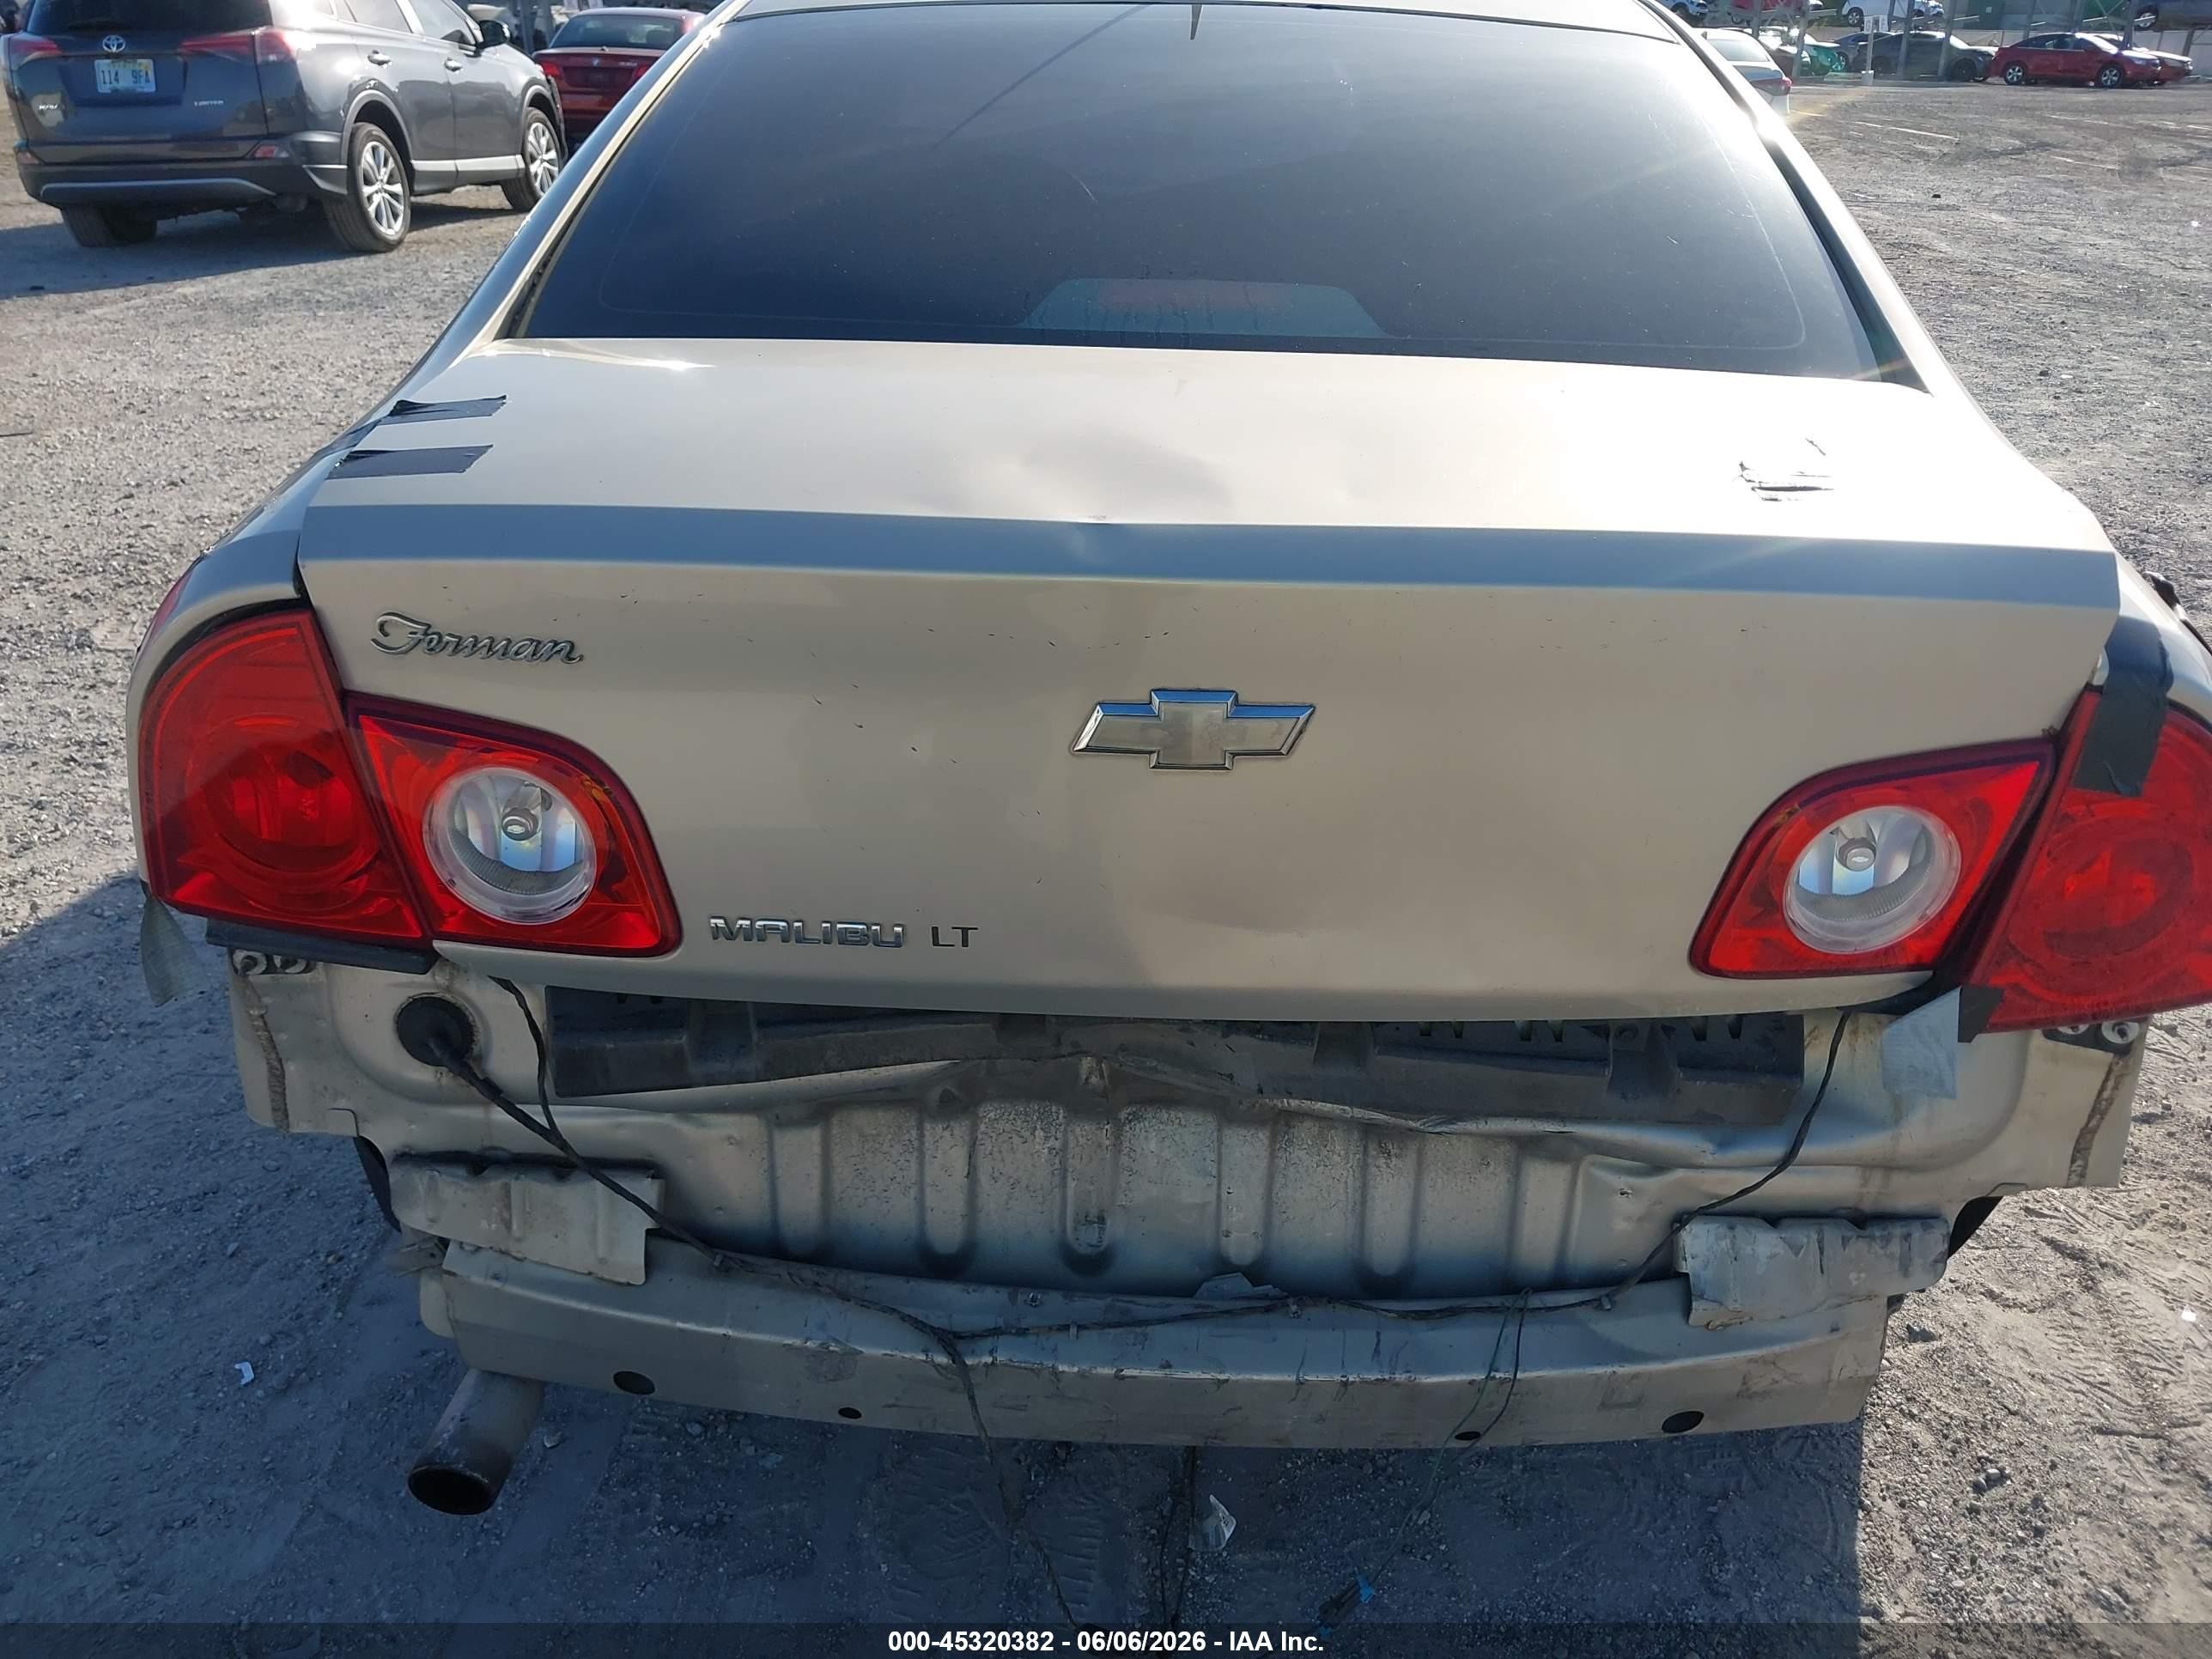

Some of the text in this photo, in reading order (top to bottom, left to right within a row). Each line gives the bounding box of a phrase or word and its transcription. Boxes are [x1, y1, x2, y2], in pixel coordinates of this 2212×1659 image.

[100, 70, 119, 84] 114
[370, 611, 585, 665] Ferman
[709, 915, 979, 949] MALIBU LT
